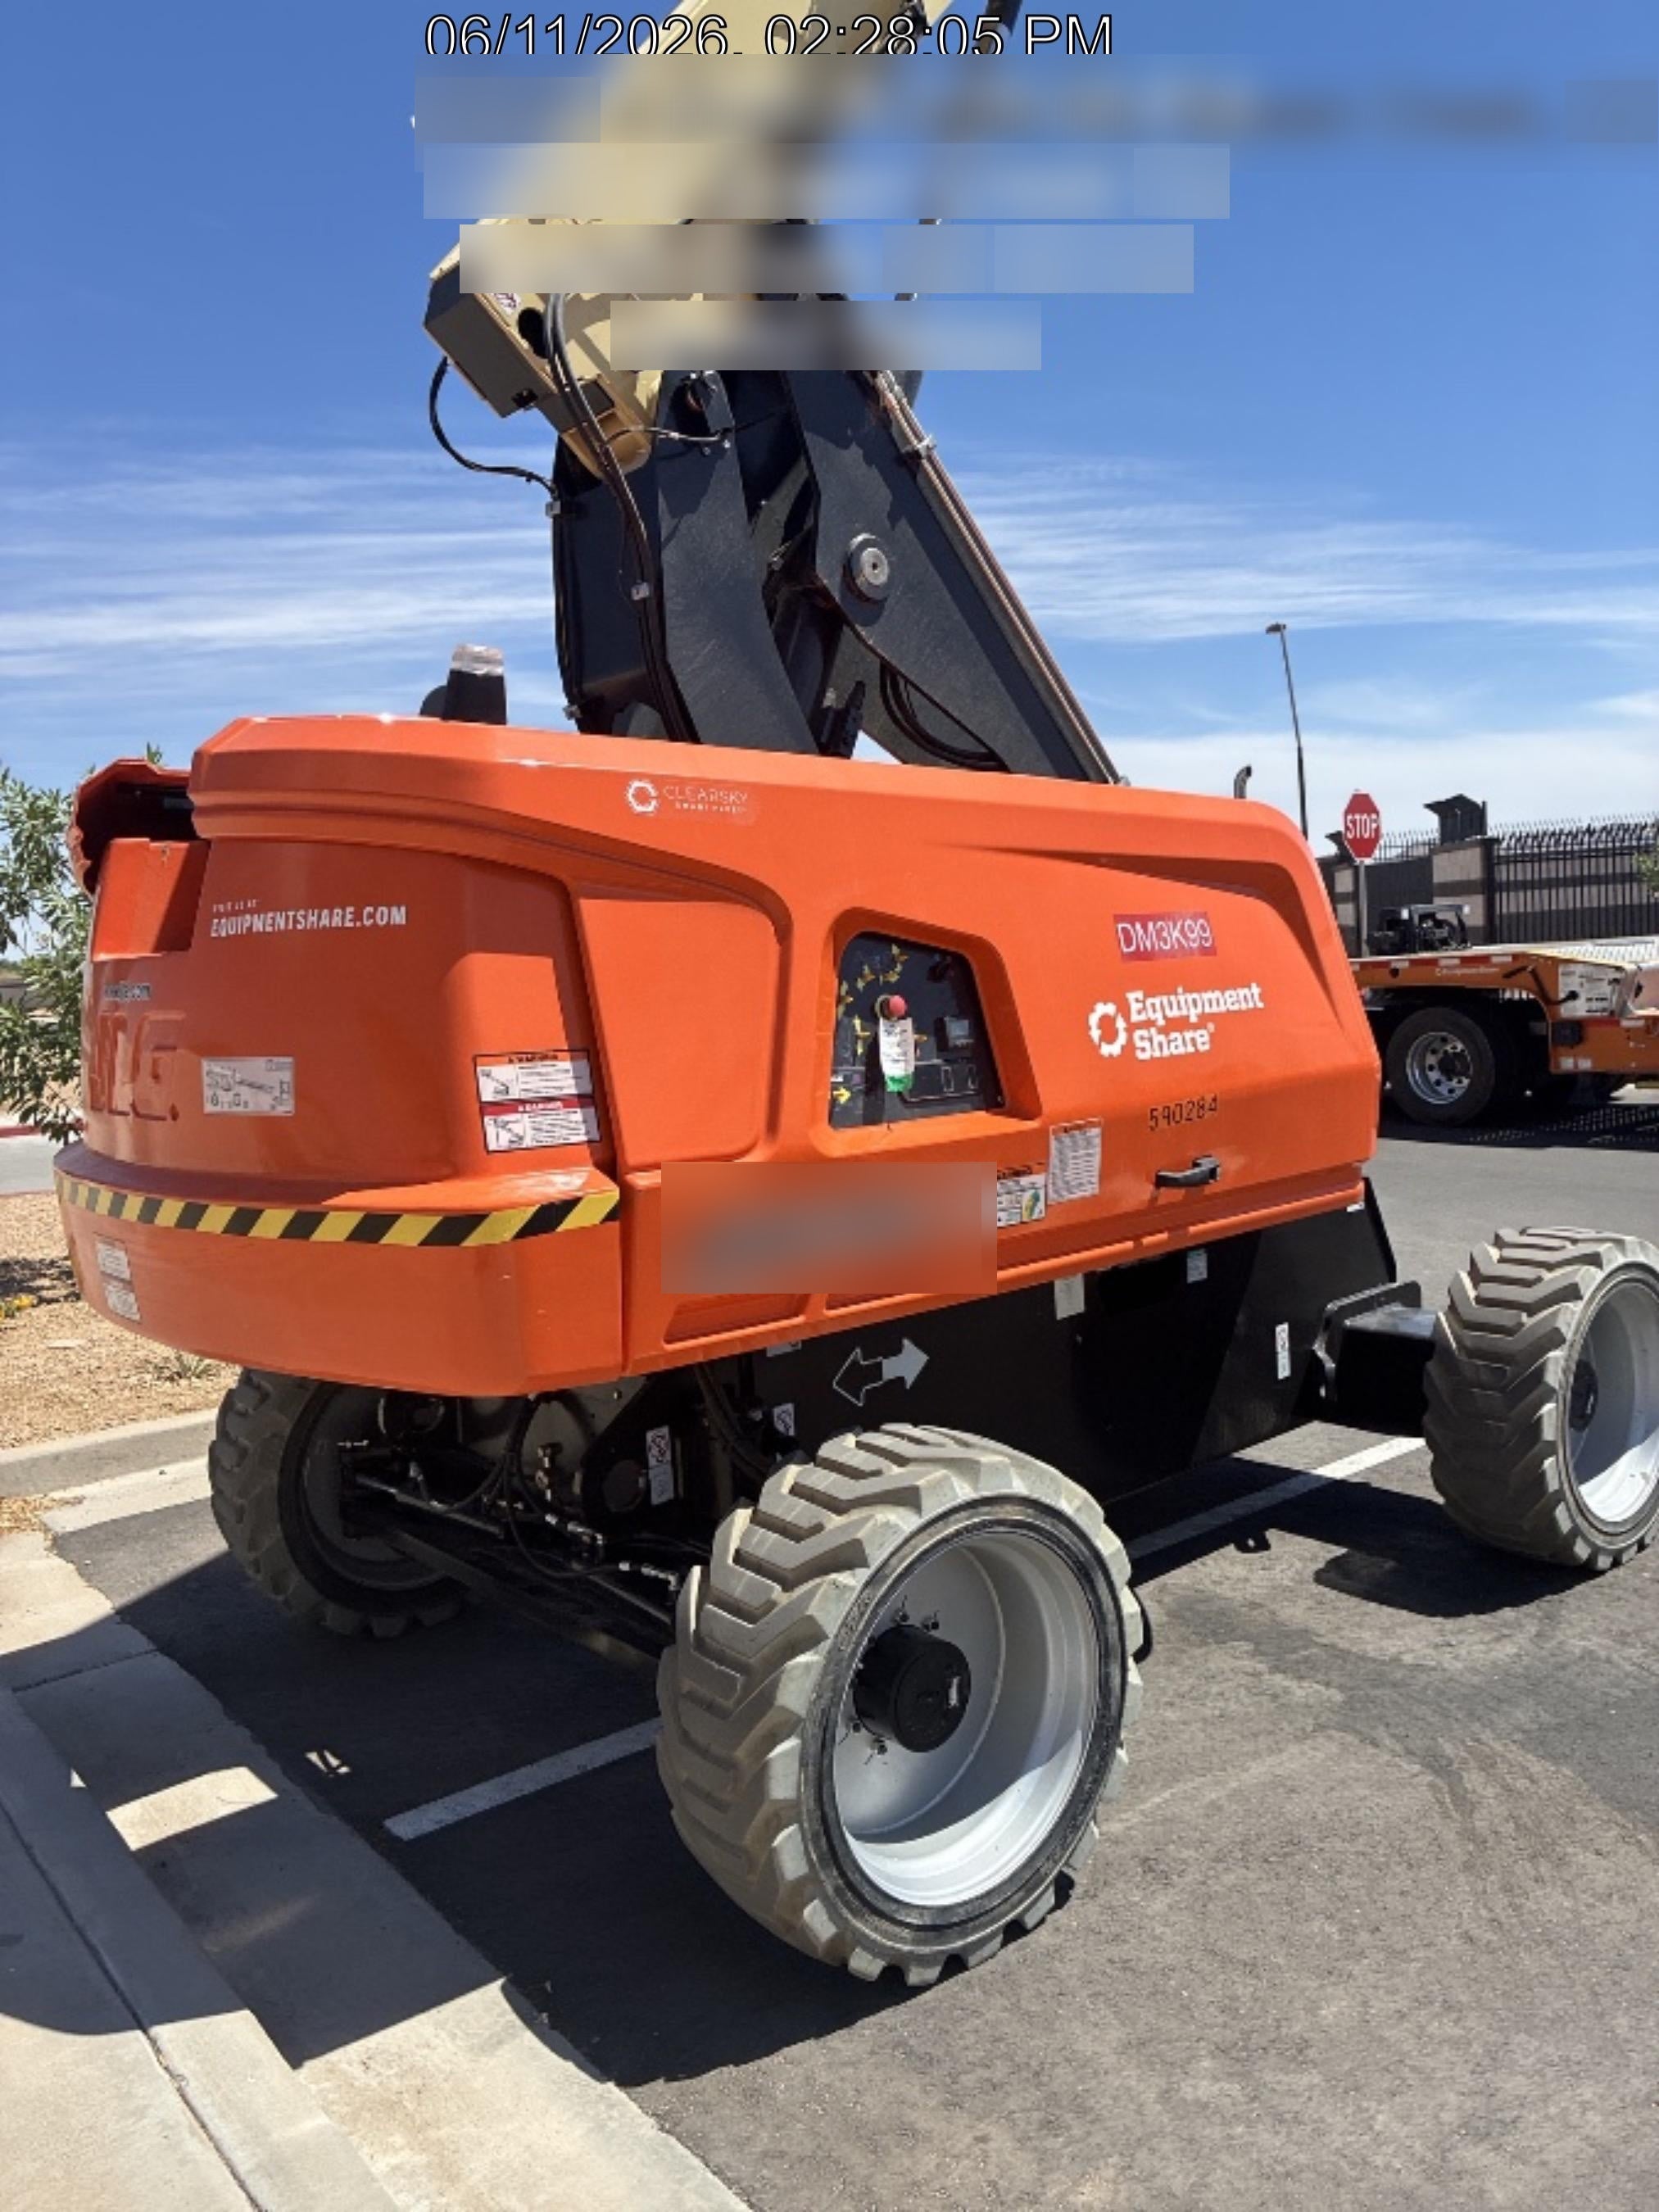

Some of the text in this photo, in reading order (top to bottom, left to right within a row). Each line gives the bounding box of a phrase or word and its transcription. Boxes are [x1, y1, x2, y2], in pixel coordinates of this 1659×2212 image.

[663, 785, 748, 805] CLEARSKY
[1346, 813, 1378, 840] STOP
[211, 904, 407, 938] EQUIPMENTSHARE.COM
[1117, 918, 1214, 953] DM3K99
[1126, 982, 1264, 1025] Equipment
